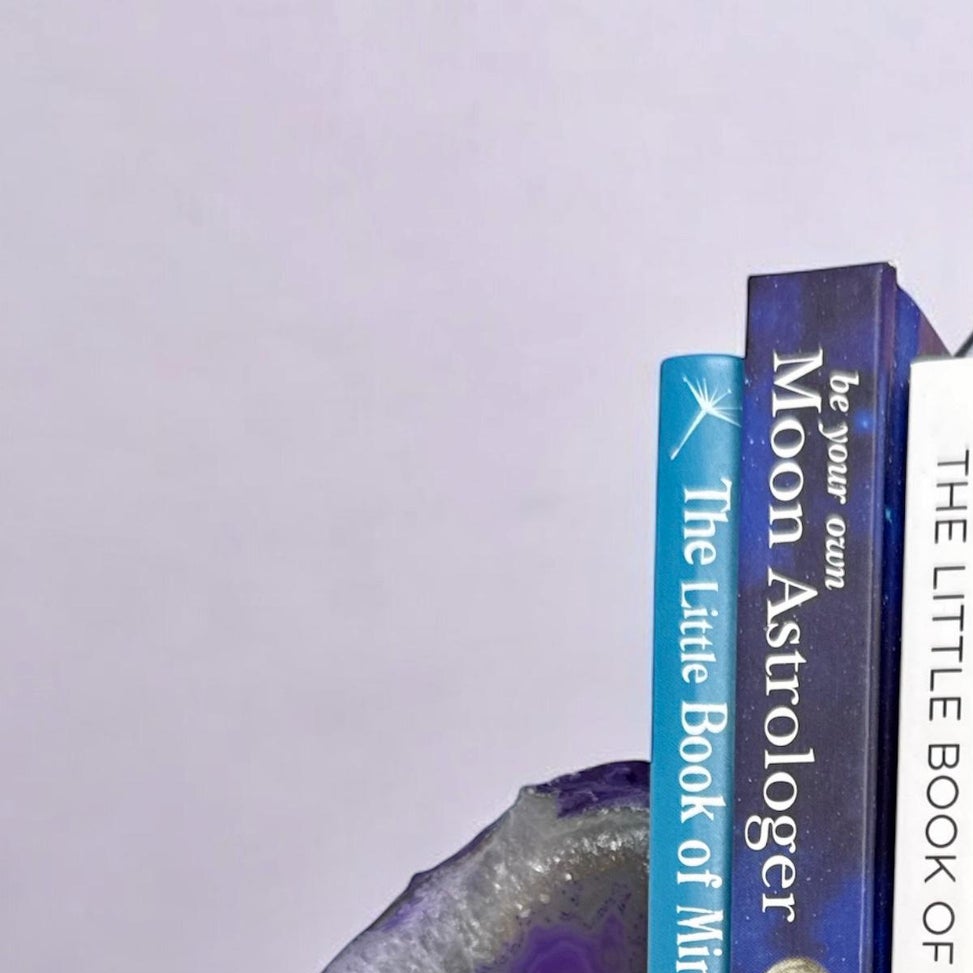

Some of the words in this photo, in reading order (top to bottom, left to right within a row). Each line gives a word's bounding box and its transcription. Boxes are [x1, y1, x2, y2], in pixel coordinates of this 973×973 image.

[829, 371, 859, 412] be
[769, 345, 823, 549] Moon
[818, 420, 848, 505] your
[683, 476, 732, 566] The
[935, 448, 969, 544] THE
[825, 516, 846, 590] own
[679, 582, 719, 684] Little
[929, 566, 965, 721] LITTLE
[678, 702, 728, 823] Book
[745, 567, 818, 923] Astrologer
[924, 743, 960, 883] BOOK
[677, 840, 723, 889] of
[922, 901, 955, 965] OF
